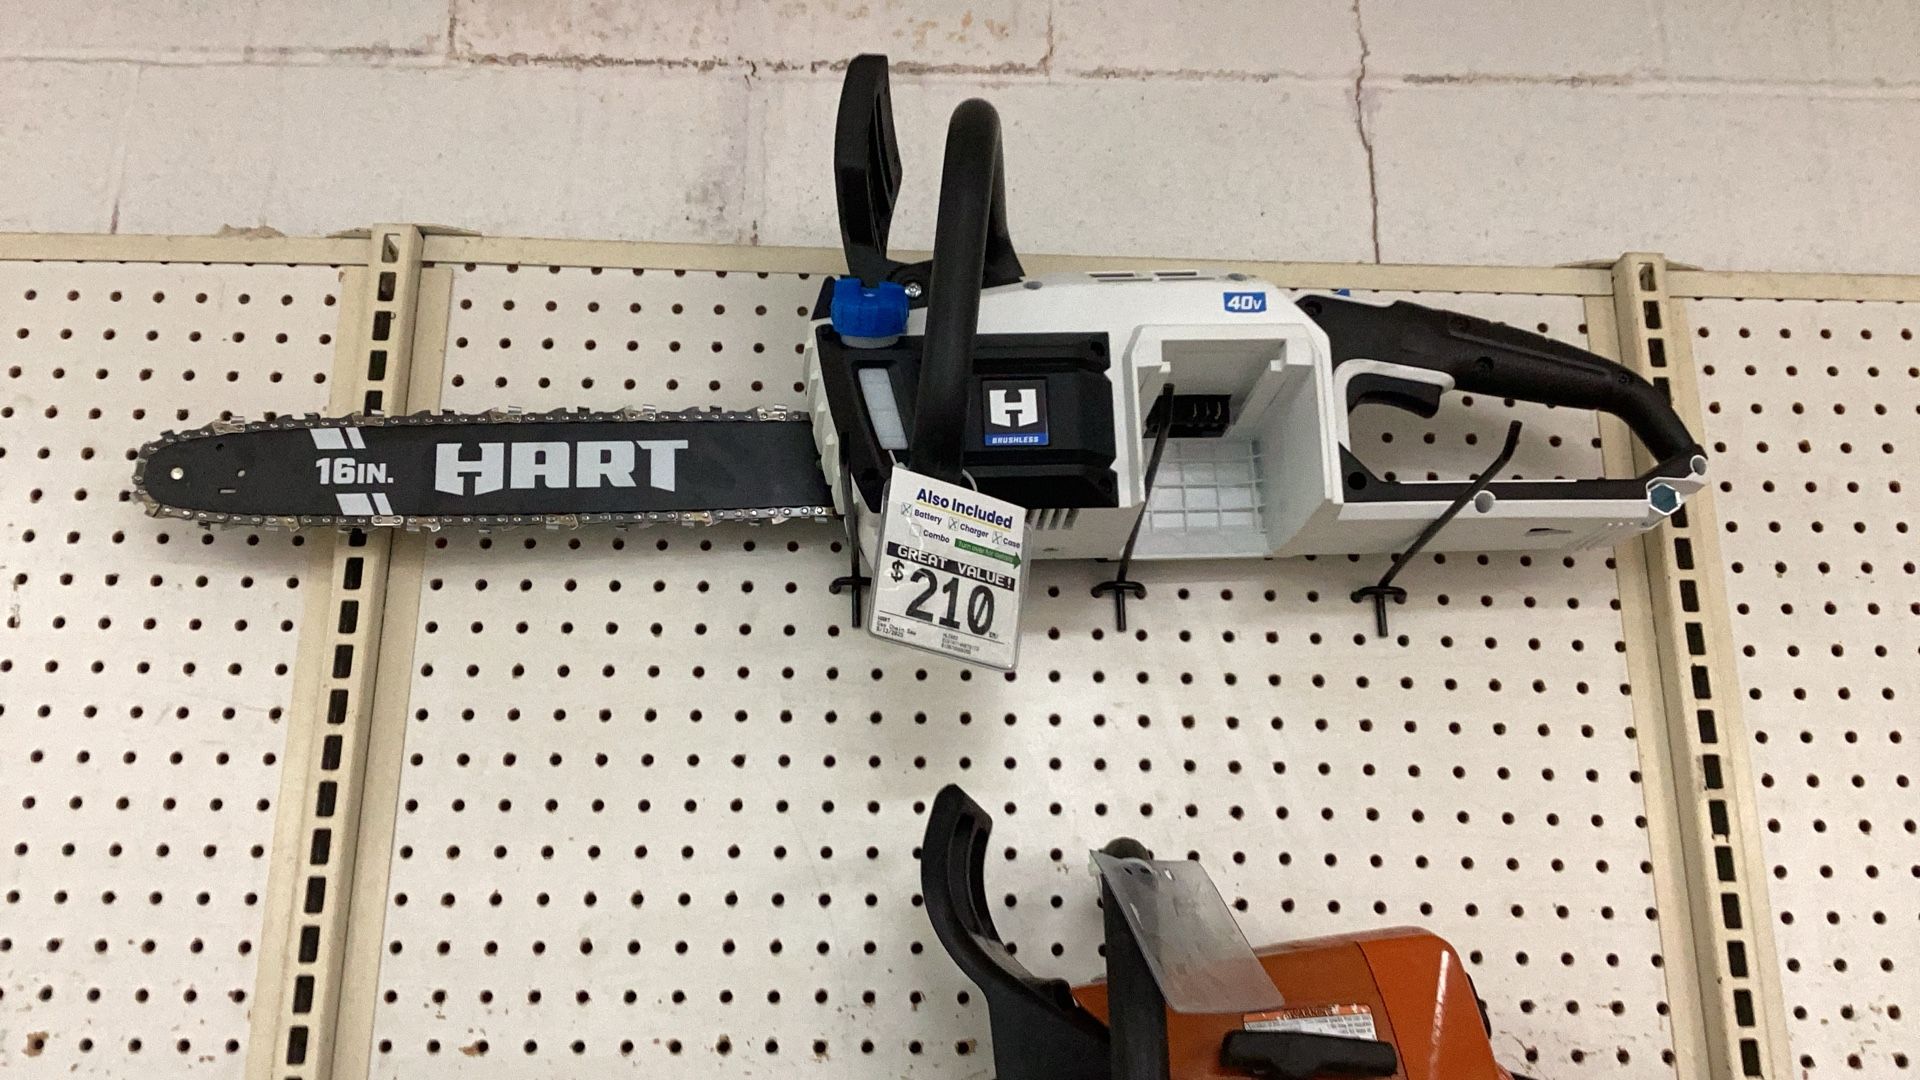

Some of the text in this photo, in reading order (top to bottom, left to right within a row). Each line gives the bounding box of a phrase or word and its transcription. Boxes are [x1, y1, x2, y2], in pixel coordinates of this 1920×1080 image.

[989, 388, 1039, 427] H
[992, 436, 1039, 444] BRUSHLESS
[315, 456, 394, 485] 16IN.
[435, 439, 689, 496] HART
[917, 488, 1013, 529] Also Included
[914, 509, 1020, 548] Battery Charger Case
[923, 529, 950, 543] Combo
[898, 546, 1012, 588] GREAT VALUE!
